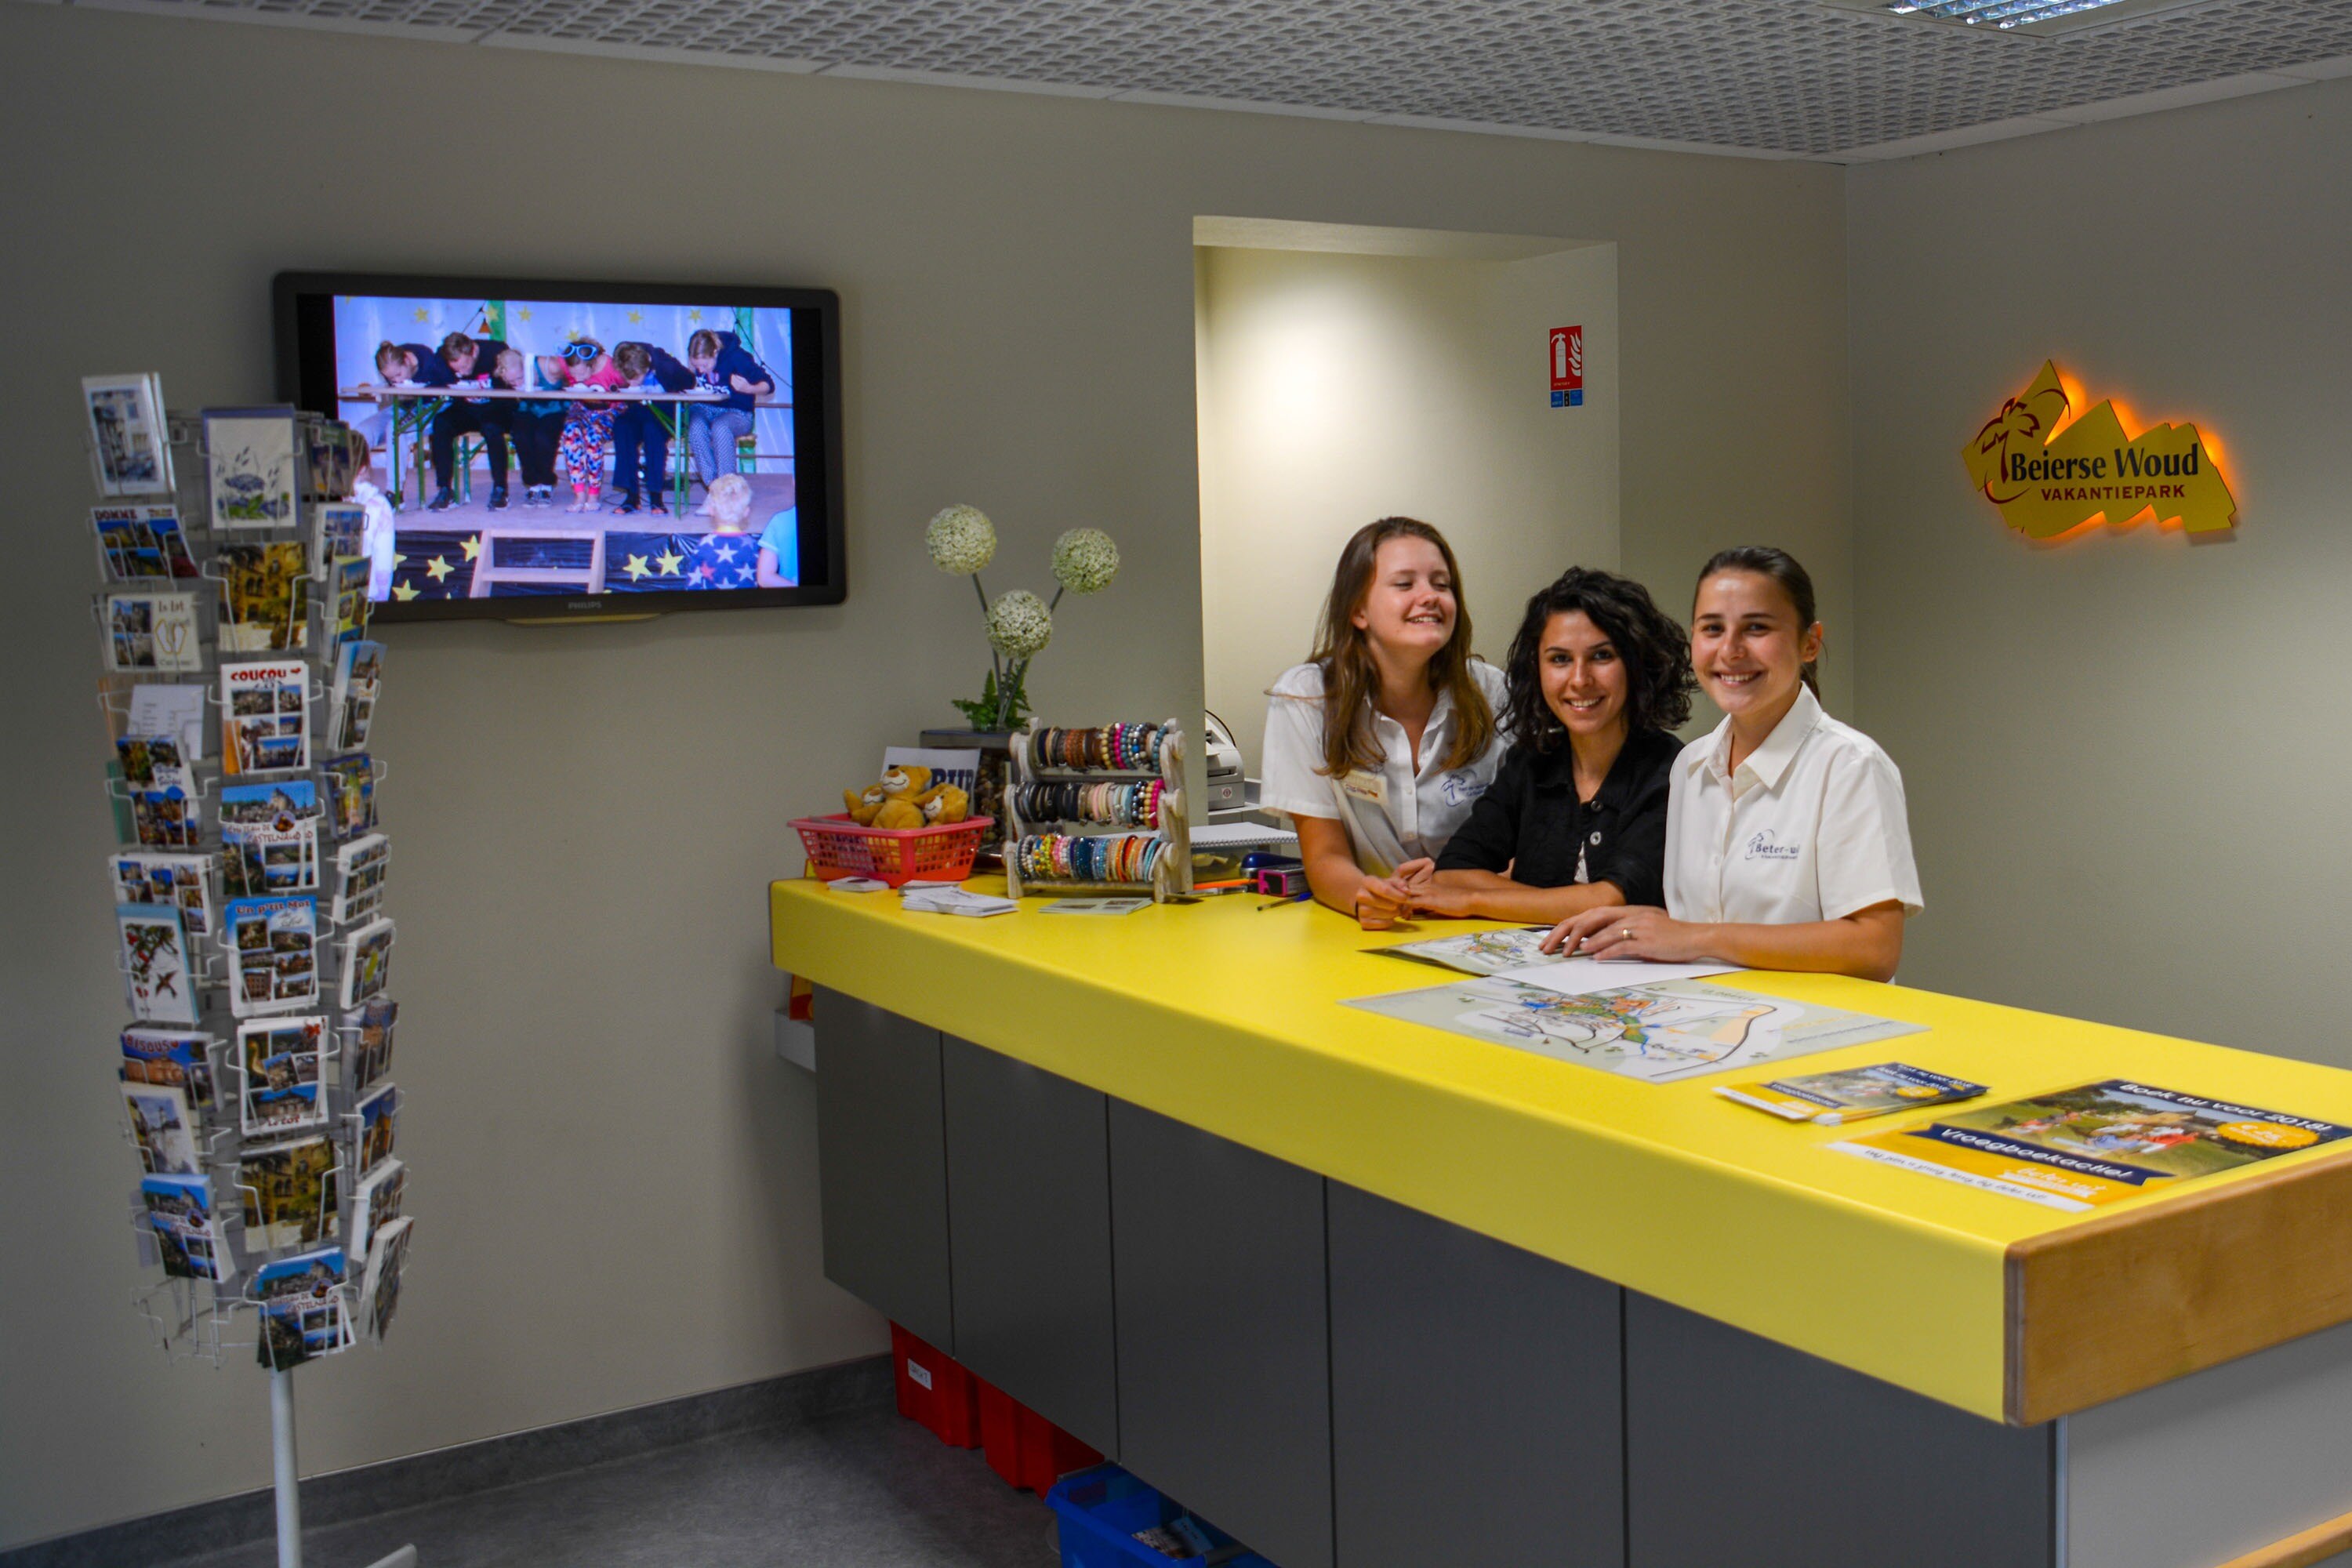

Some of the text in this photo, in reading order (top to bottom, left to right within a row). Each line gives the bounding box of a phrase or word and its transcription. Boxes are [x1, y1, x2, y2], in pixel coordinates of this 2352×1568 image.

[2011, 443, 2198, 481] Beierse Woud
[2042, 485, 2185, 501] VAKANTIEPARK
[568, 601, 603, 609] PHILIPS
[2119, 1083, 2333, 1131] Boek nu voor 2018!
[1940, 1127, 2133, 1178] Vroegboekactie!
